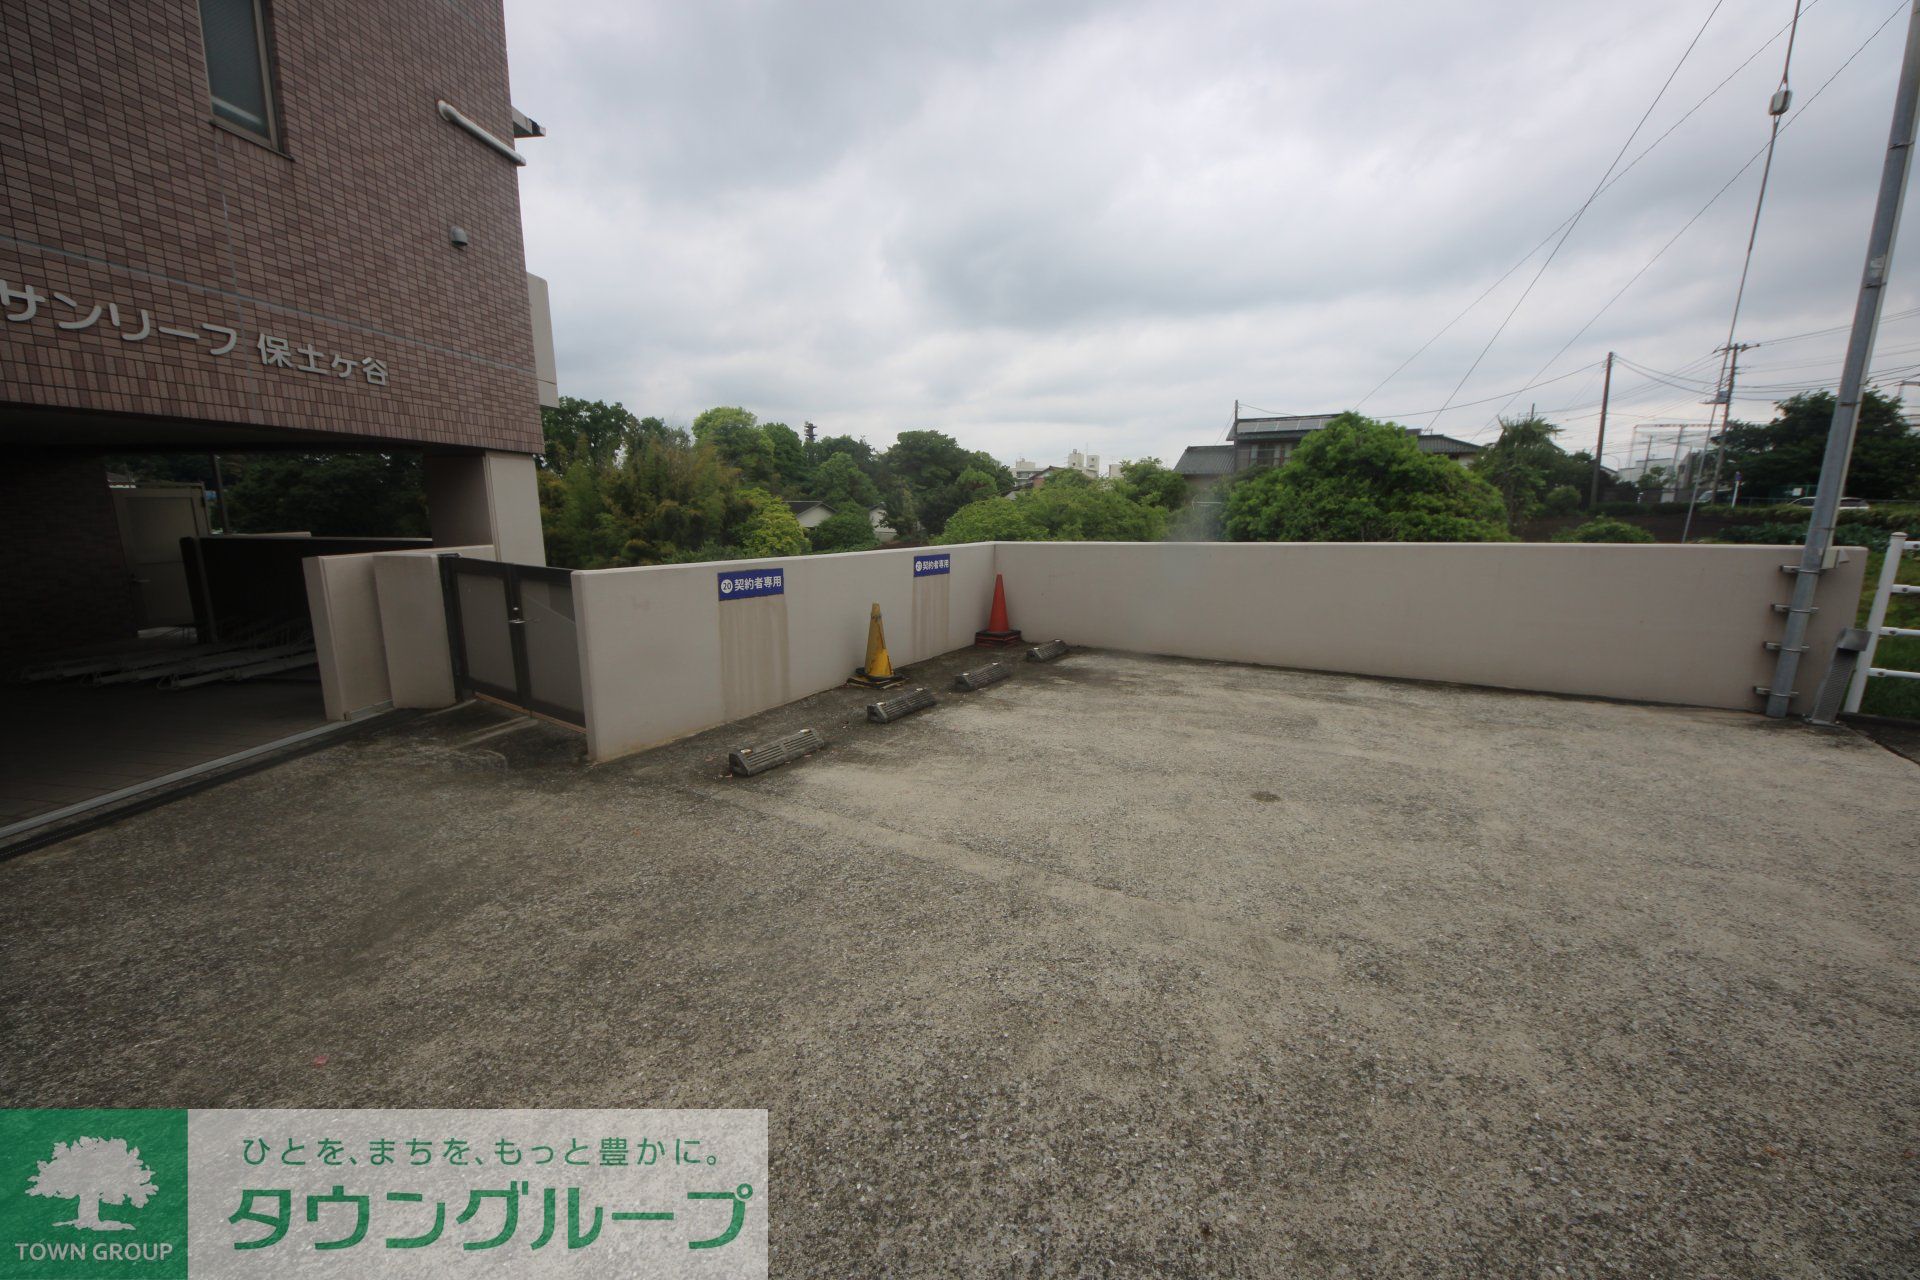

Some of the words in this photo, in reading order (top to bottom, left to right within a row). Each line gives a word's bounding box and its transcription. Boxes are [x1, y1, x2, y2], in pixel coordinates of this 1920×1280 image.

[0, 279, 238, 356] サンリーフ
[734, 576, 782, 591] 契約者専用
